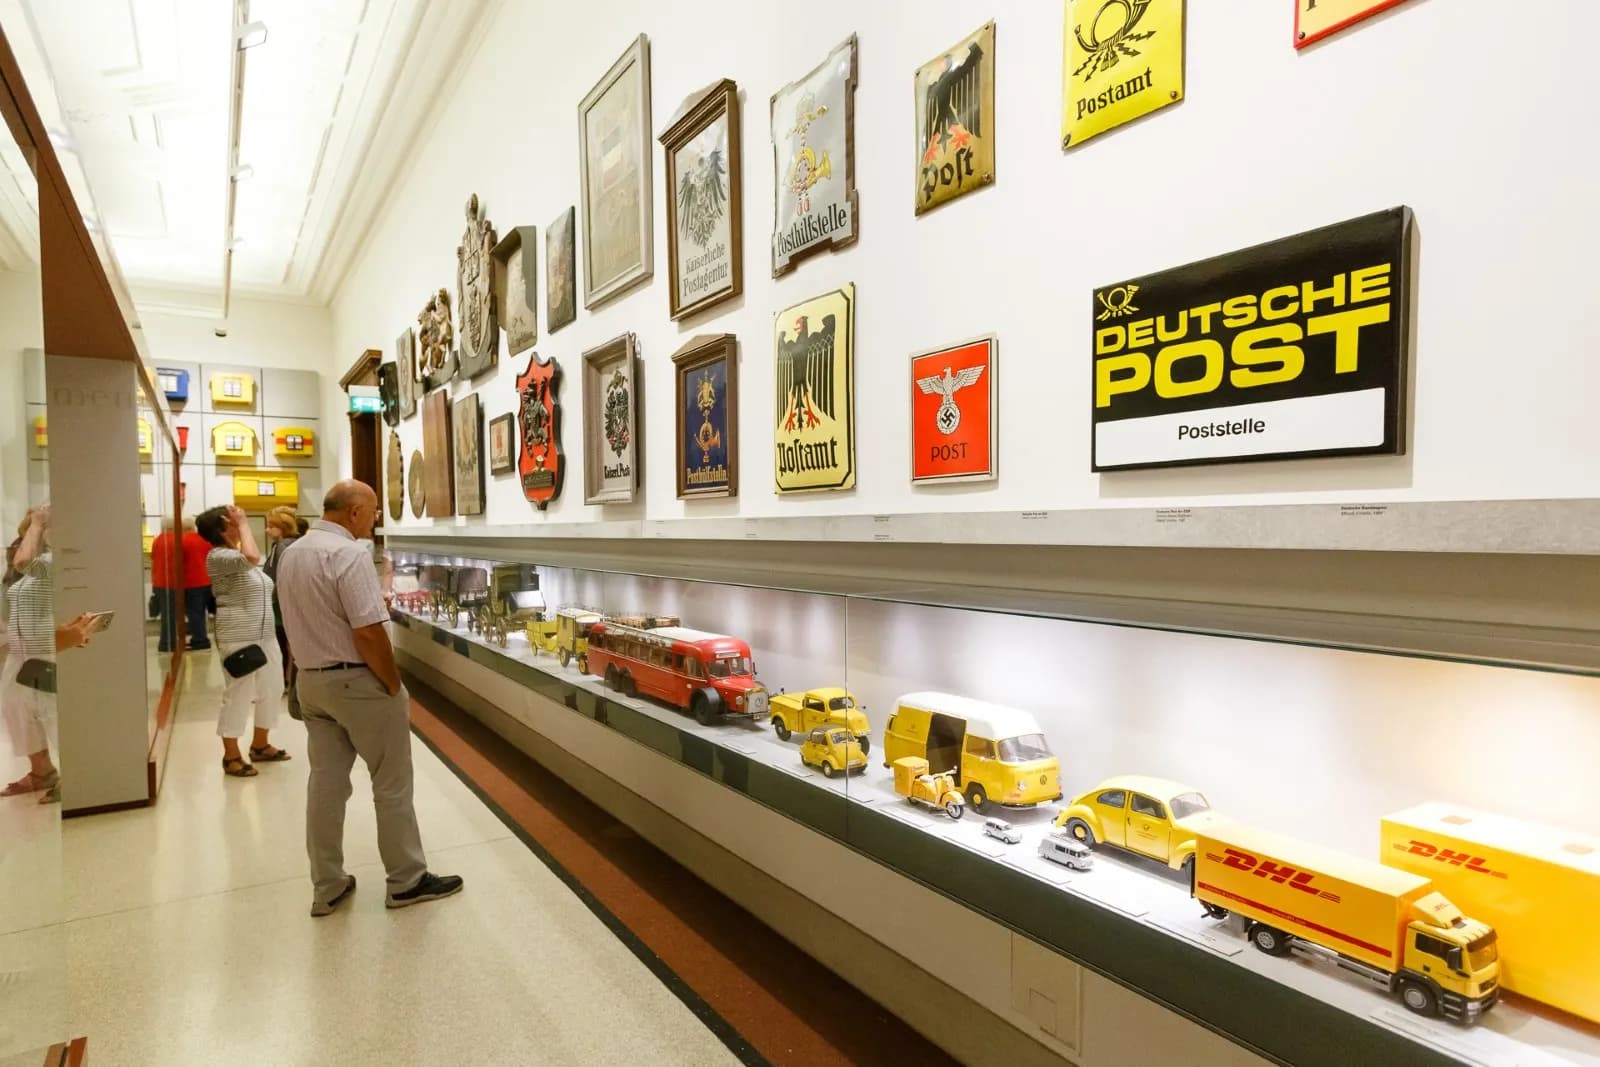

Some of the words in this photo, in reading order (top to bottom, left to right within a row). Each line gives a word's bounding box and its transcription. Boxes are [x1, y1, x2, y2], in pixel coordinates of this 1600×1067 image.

[1076, 66, 1153, 120] Postamt
[683, 262, 728, 297] Postagentur
[1095, 262, 1392, 355] DEUTSCHE
[1095, 302, 1392, 408] POST
[1178, 417, 1266, 441] Poststelle
[931, 442, 968, 462] POST
[1222, 848, 1320, 895] DHL
[1408, 840, 1491, 873] DHL
